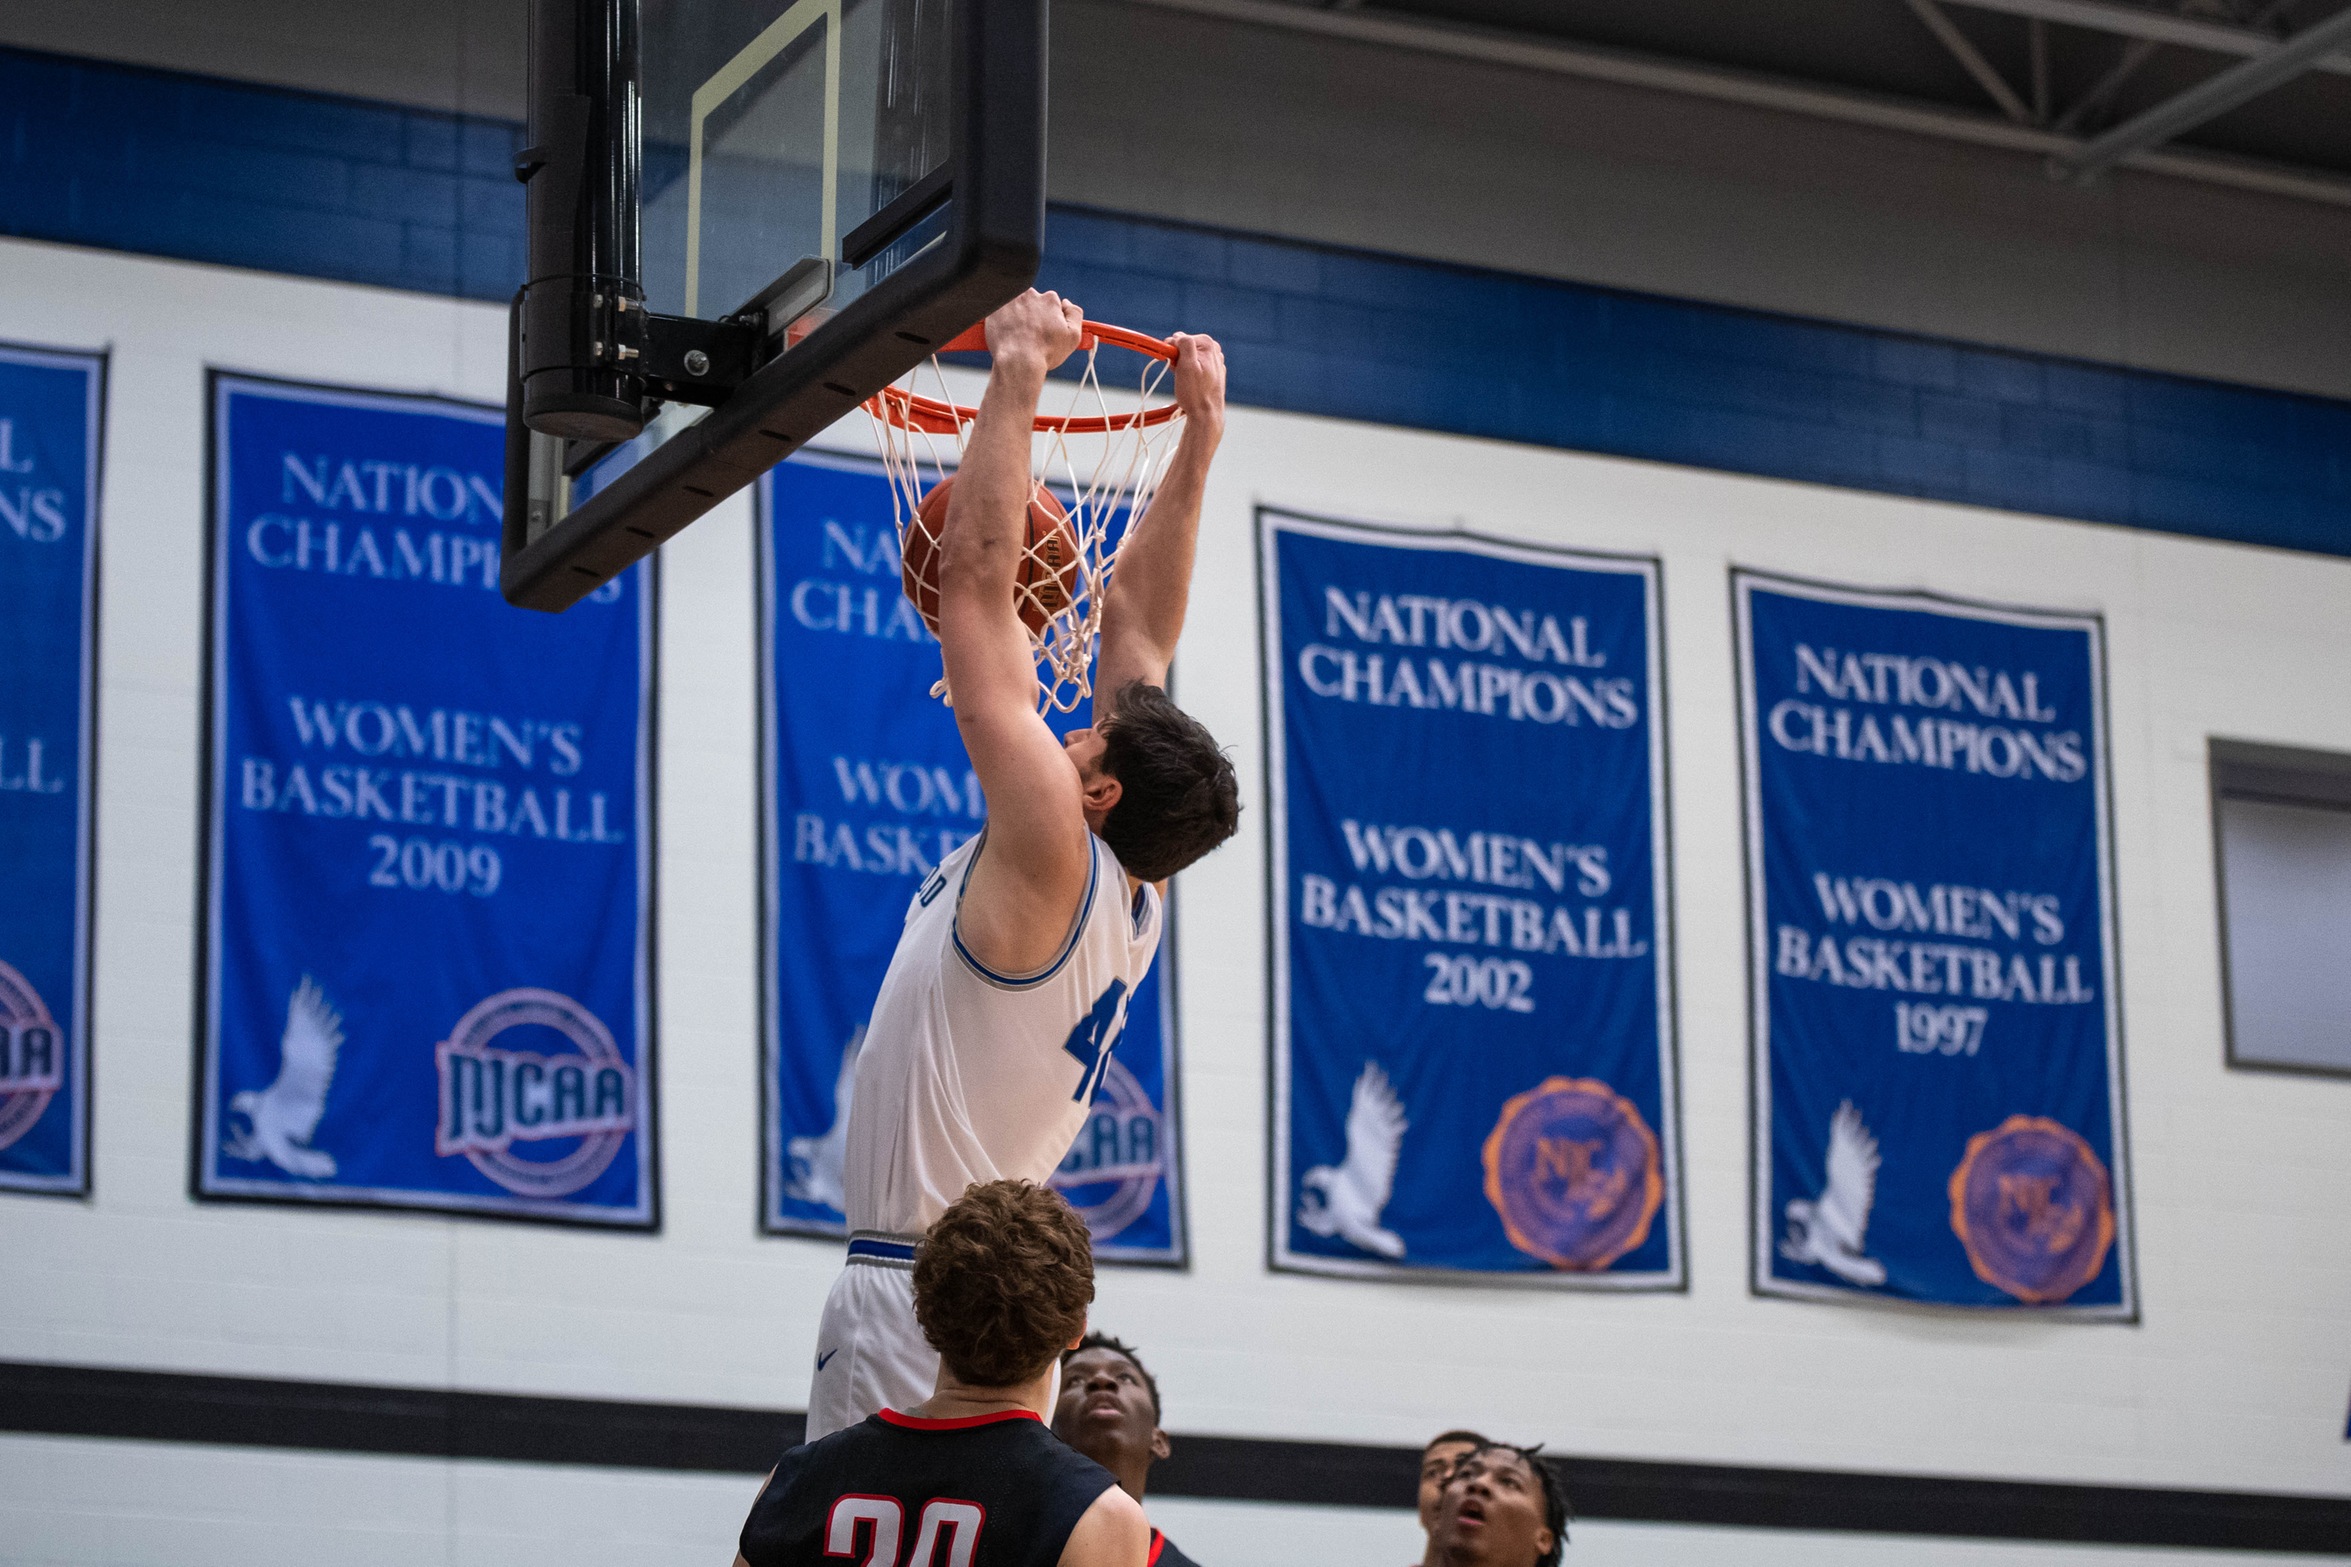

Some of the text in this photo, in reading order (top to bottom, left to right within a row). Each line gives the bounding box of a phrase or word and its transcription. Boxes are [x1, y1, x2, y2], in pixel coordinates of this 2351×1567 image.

[282, 452, 503, 525] NATION
[1325, 586, 1607, 668] NATIONAL
[1300, 643, 1638, 729] CHAMPIONS
[1796, 643, 2056, 723] NATIONAL
[289, 696, 583, 776] WOMEN'S
[1769, 699, 2087, 783] CHAMPIONS
[241, 758, 624, 842] BASKETBALL
[367, 834, 501, 896] 2009
[1342, 818, 1612, 897] WOMEN'S
[1301, 873, 1648, 959] BASKETBALL
[1814, 871, 2064, 946] WOMEN'S
[1424, 952, 1535, 1013] 2002
[1775, 924, 2093, 1005] BASKETBALL
[1062, 976, 1129, 1107] 4
[1894, 1002, 1988, 1057] 1997
